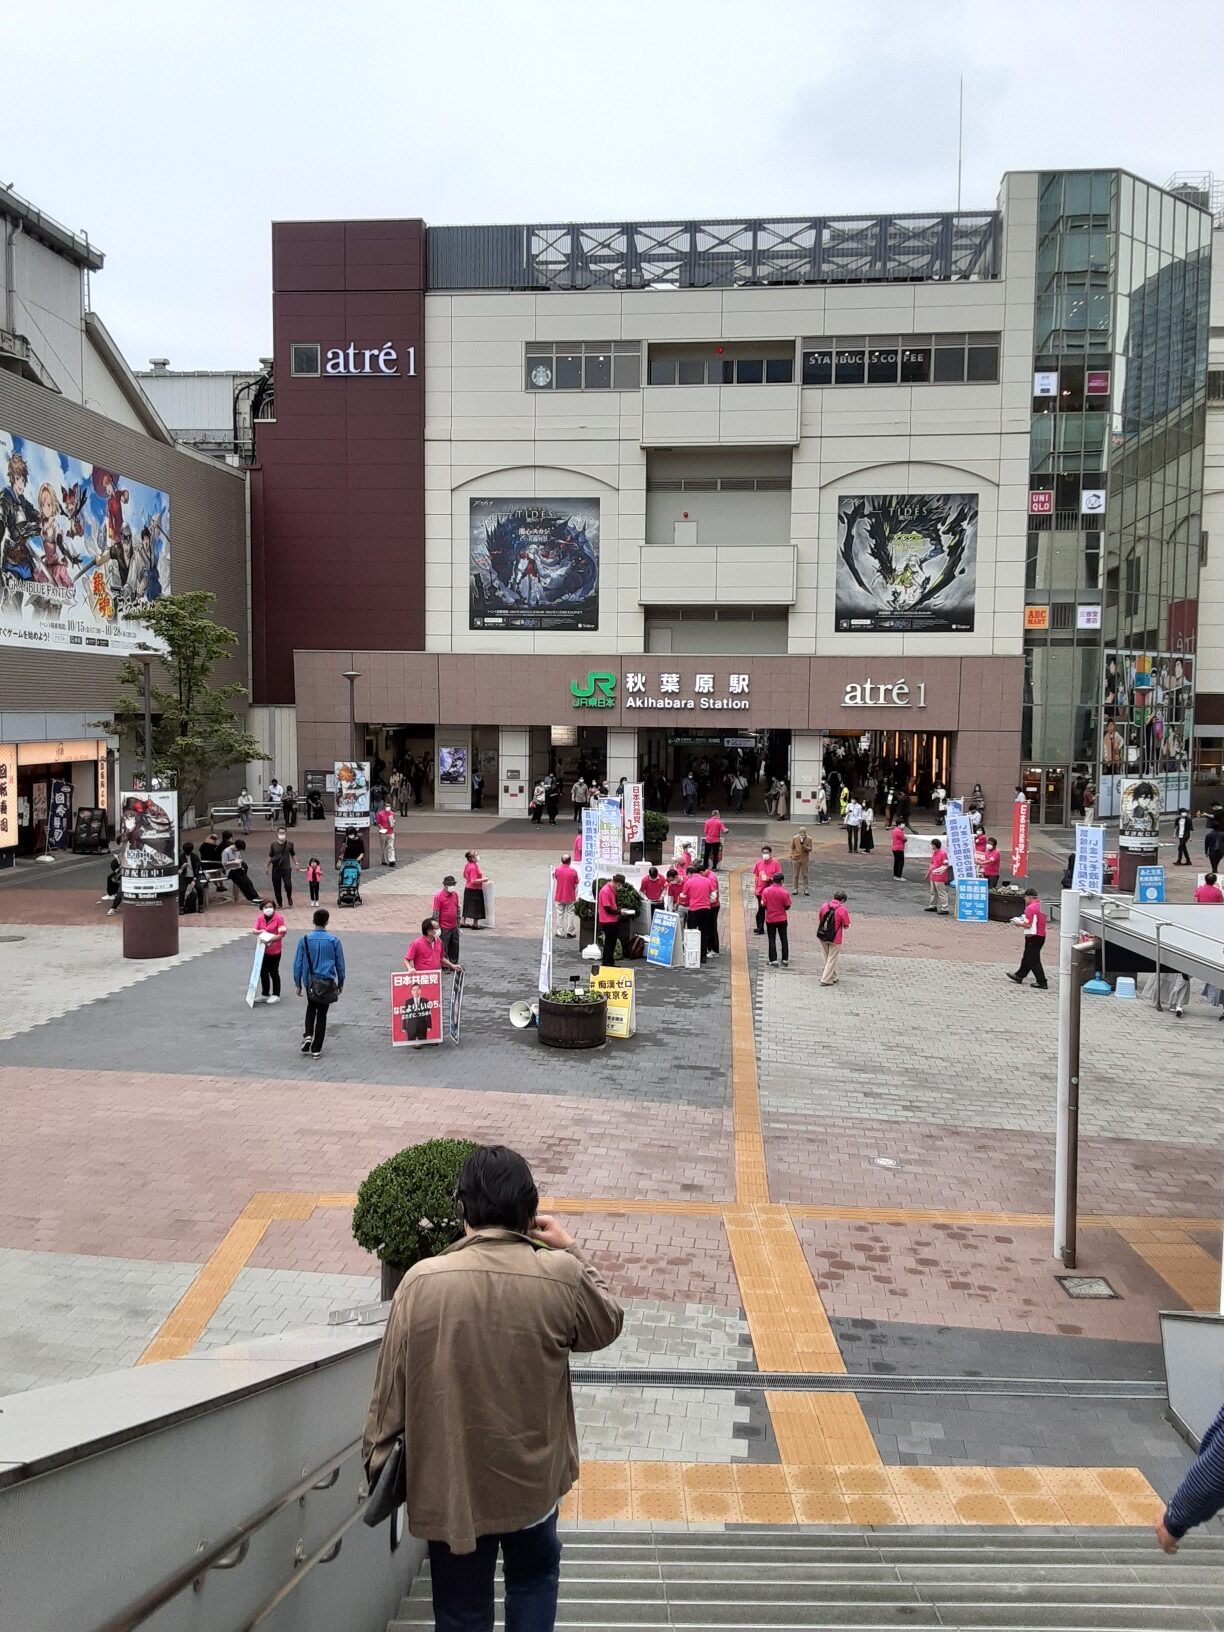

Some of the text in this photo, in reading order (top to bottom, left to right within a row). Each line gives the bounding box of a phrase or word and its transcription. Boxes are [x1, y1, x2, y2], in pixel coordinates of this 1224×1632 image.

[326, 341, 398, 375] atré
[809, 353, 924, 365] STABUCS COFEE
[1032, 494, 1049, 502] UNI
[888, 507, 927, 516] TIDES
[1032, 502, 1050, 511] QLO
[516, 510, 553, 518] TIDES
[1028, 610, 1046, 619] ABC
[570, 671, 617, 697] JR
[626, 673, 750, 694] 秋葉原駅
[843, 677, 909, 706] atré
[572, 697, 616, 708] JR東日本
[626, 697, 750, 709] Akihabara Station
[632, 785, 641, 824] 日本共産党
[393, 974, 439, 987] 日本共産党
[393, 1000, 441, 1015] なにより、いのち。
